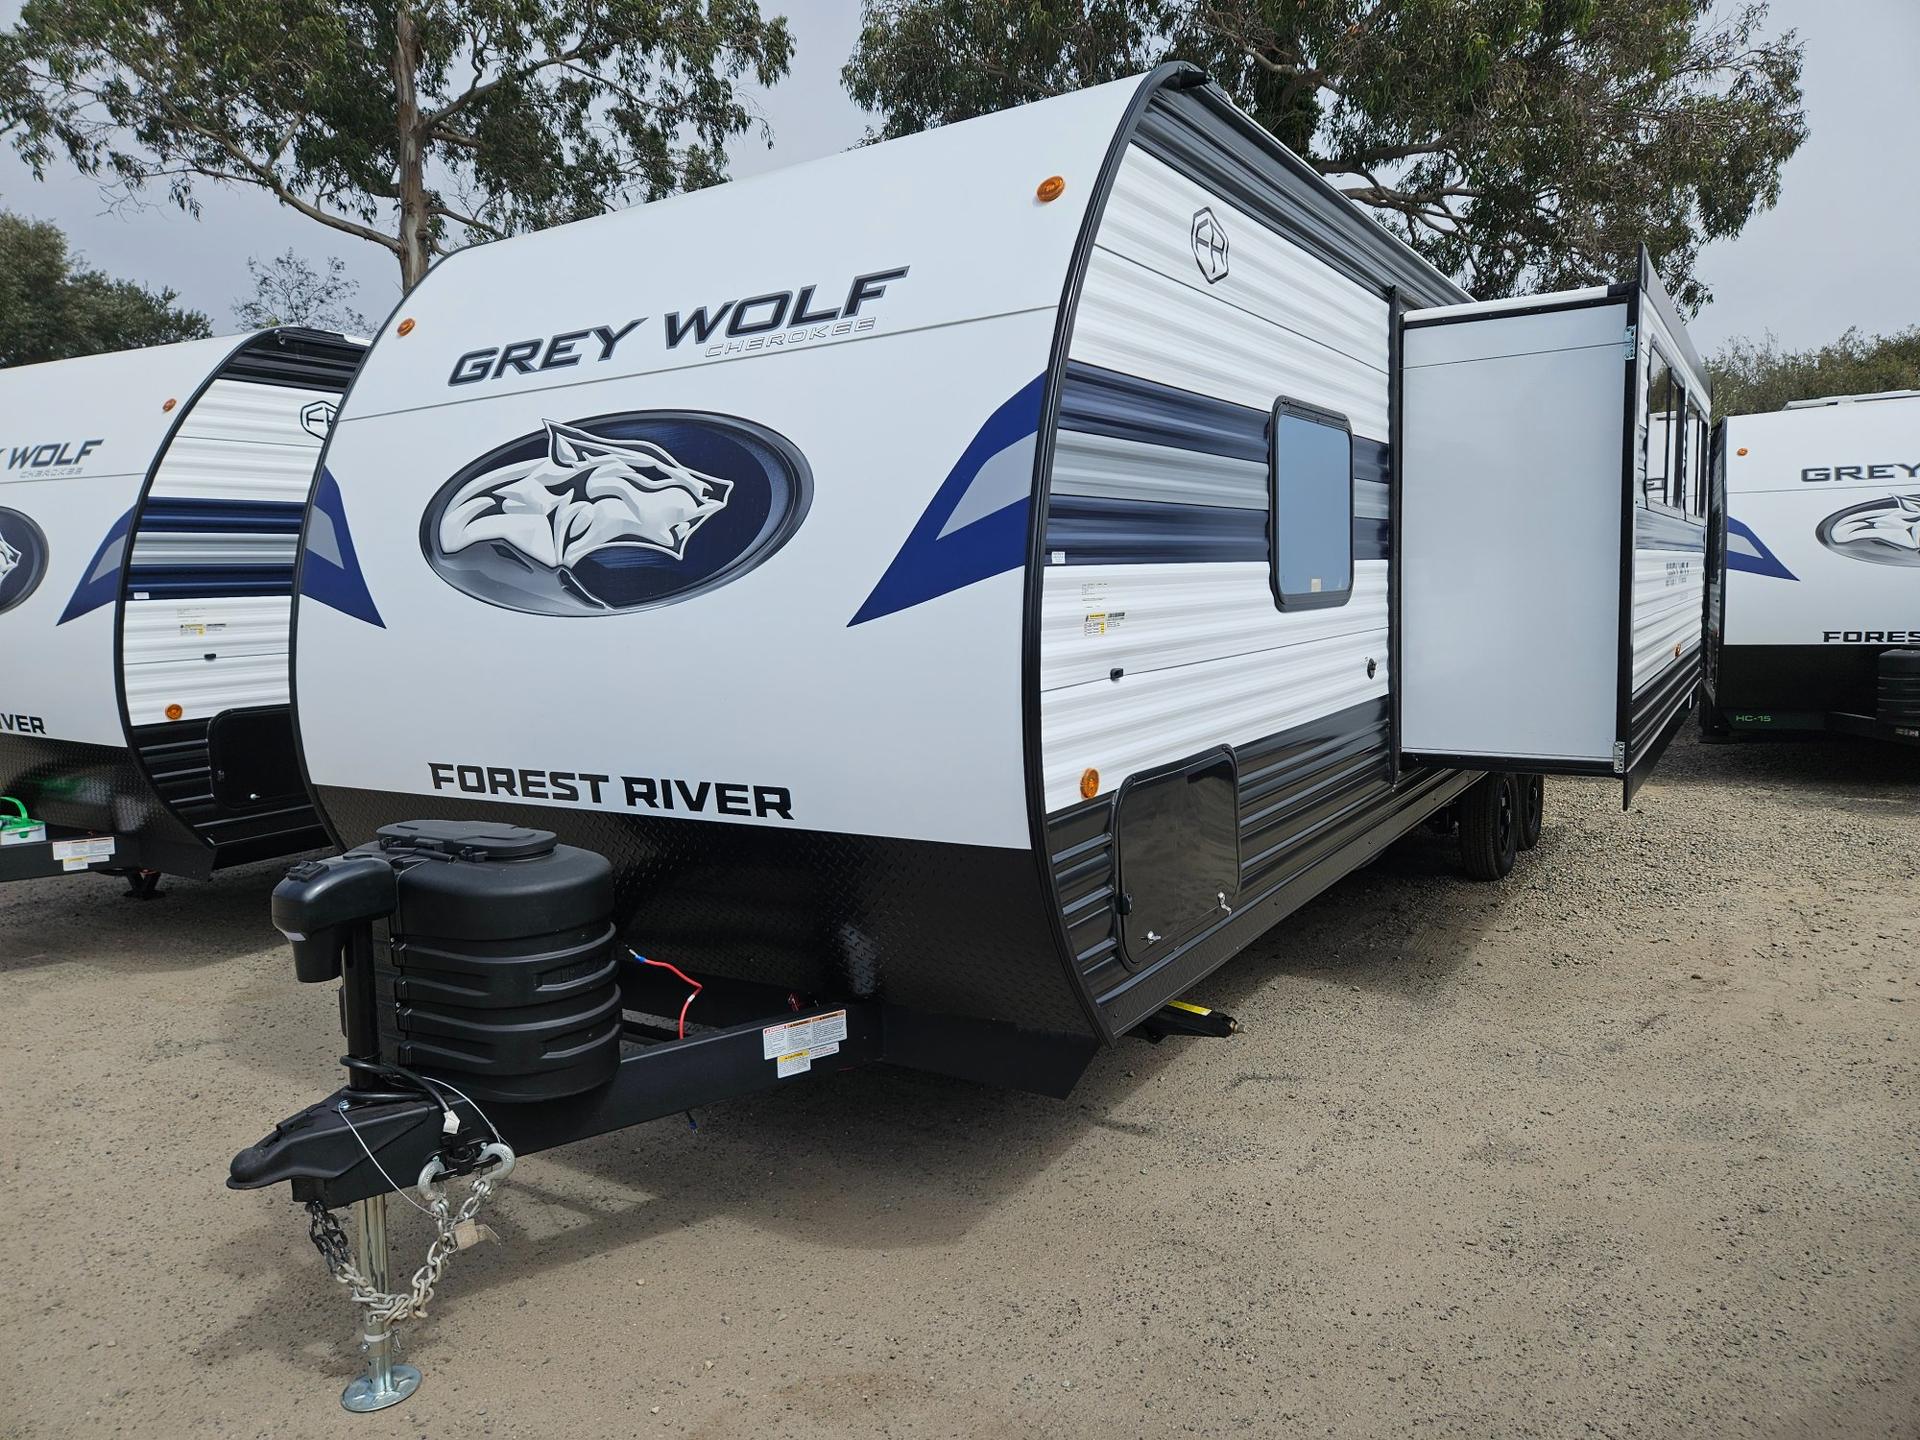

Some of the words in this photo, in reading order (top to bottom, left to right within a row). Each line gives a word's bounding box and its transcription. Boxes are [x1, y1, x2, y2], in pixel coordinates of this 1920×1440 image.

[447, 317, 649, 387] GREY
[664, 265, 910, 350] WOLF
[704, 317, 877, 358] CHEROKEE
[7, 438, 105, 470] WOLF
[427, 762, 610, 804] FOREST
[620, 775, 795, 820] RIVER
